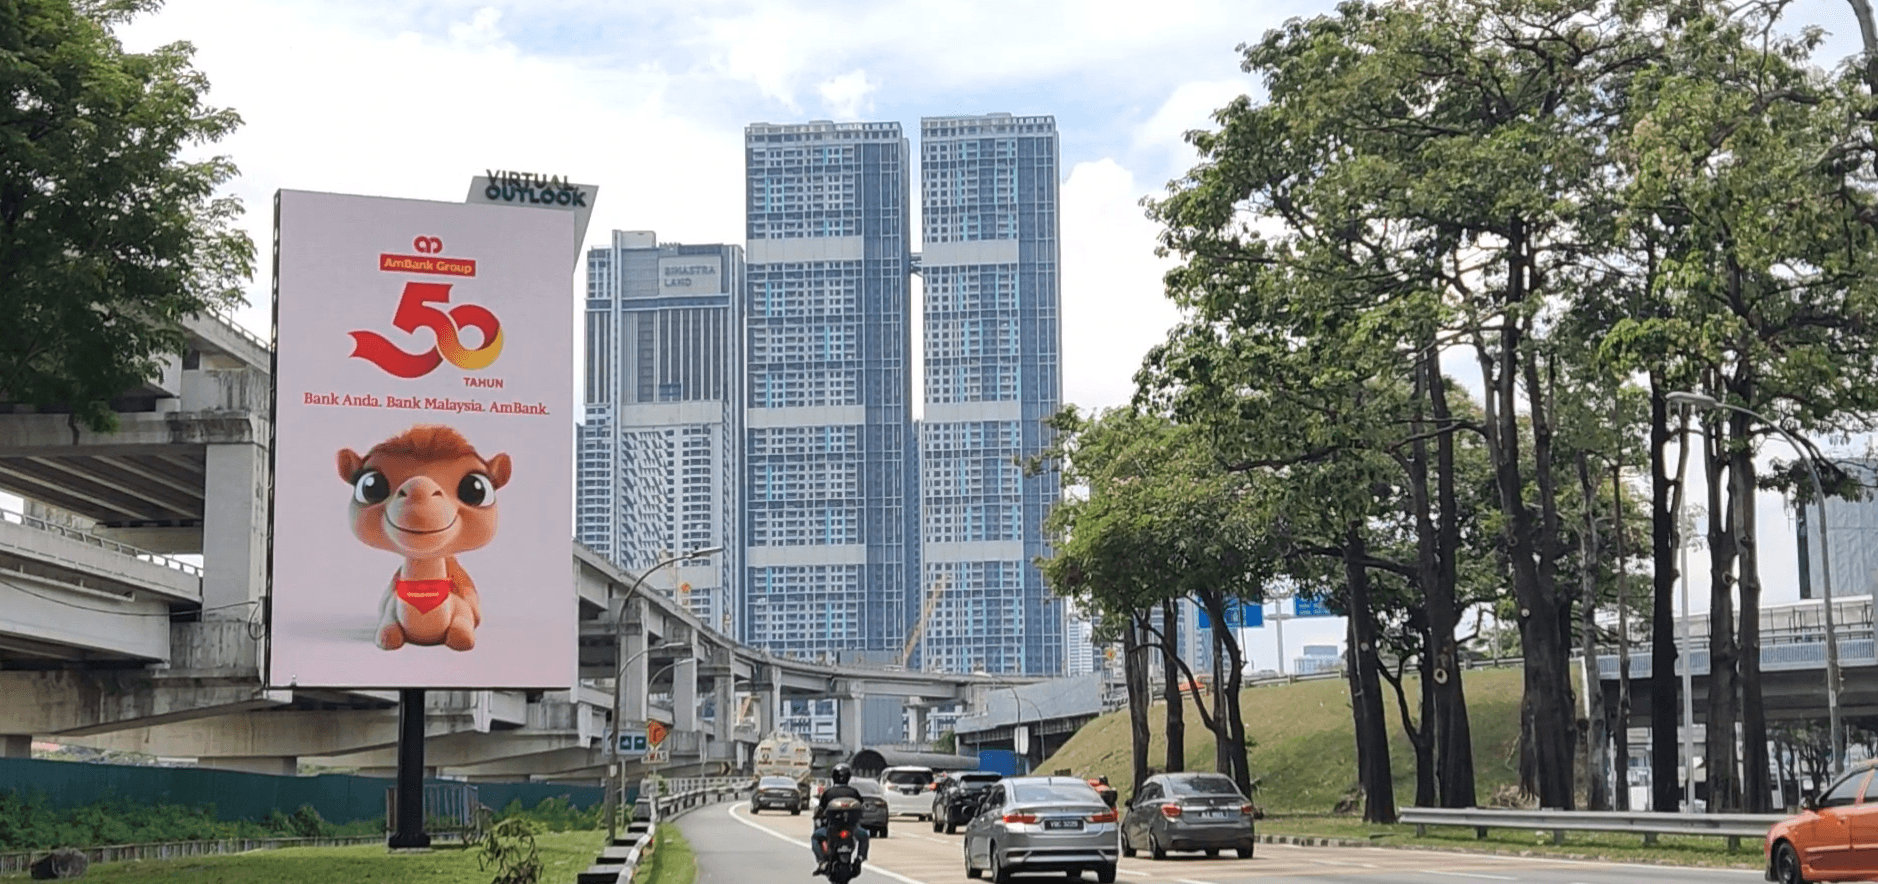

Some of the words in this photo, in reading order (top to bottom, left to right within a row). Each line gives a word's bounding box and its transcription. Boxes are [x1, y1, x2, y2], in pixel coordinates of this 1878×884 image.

[486, 169, 574, 191] VIRTUAL
[485, 184, 587, 207] OUTLOOK
[384, 258, 434, 270] AmBank
[436, 261, 472, 274] Group
[664, 278, 692, 287] LAND
[347, 281, 504, 379] 50
[463, 377, 504, 388] TAHUN
[303, 392, 340, 406] Bank
[342, 394, 383, 408] Anda.
[386, 396, 422, 410] Bank
[424, 398, 486, 414] Malaysia.
[489, 402, 551, 416] AmBank.
